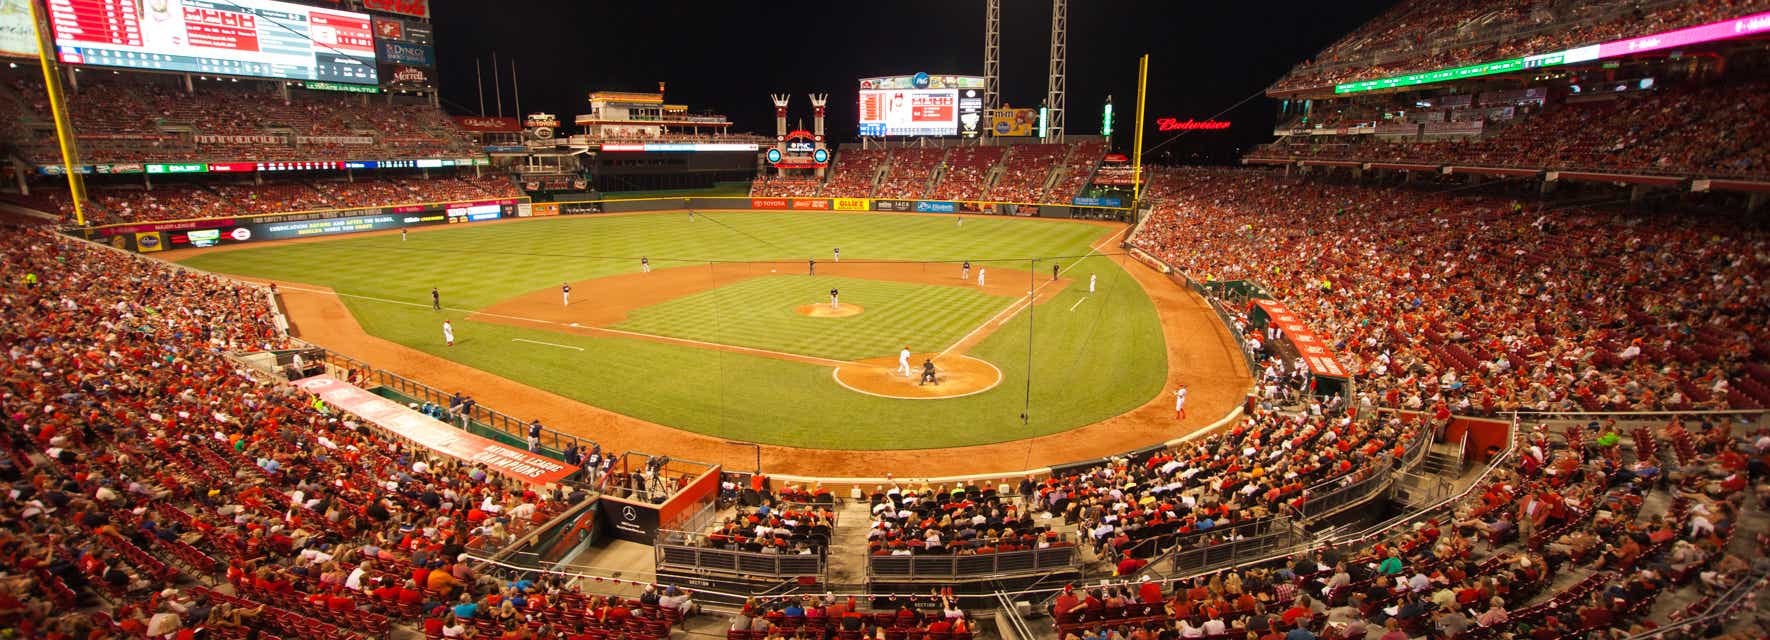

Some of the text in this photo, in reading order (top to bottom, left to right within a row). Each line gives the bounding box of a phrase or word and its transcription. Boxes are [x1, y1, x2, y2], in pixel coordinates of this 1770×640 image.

[1157, 118, 1231, 131] Budweiser
[473, 451, 546, 478] CHAMPIONS
[483, 445, 564, 473] NATIONAL LEAGUE
